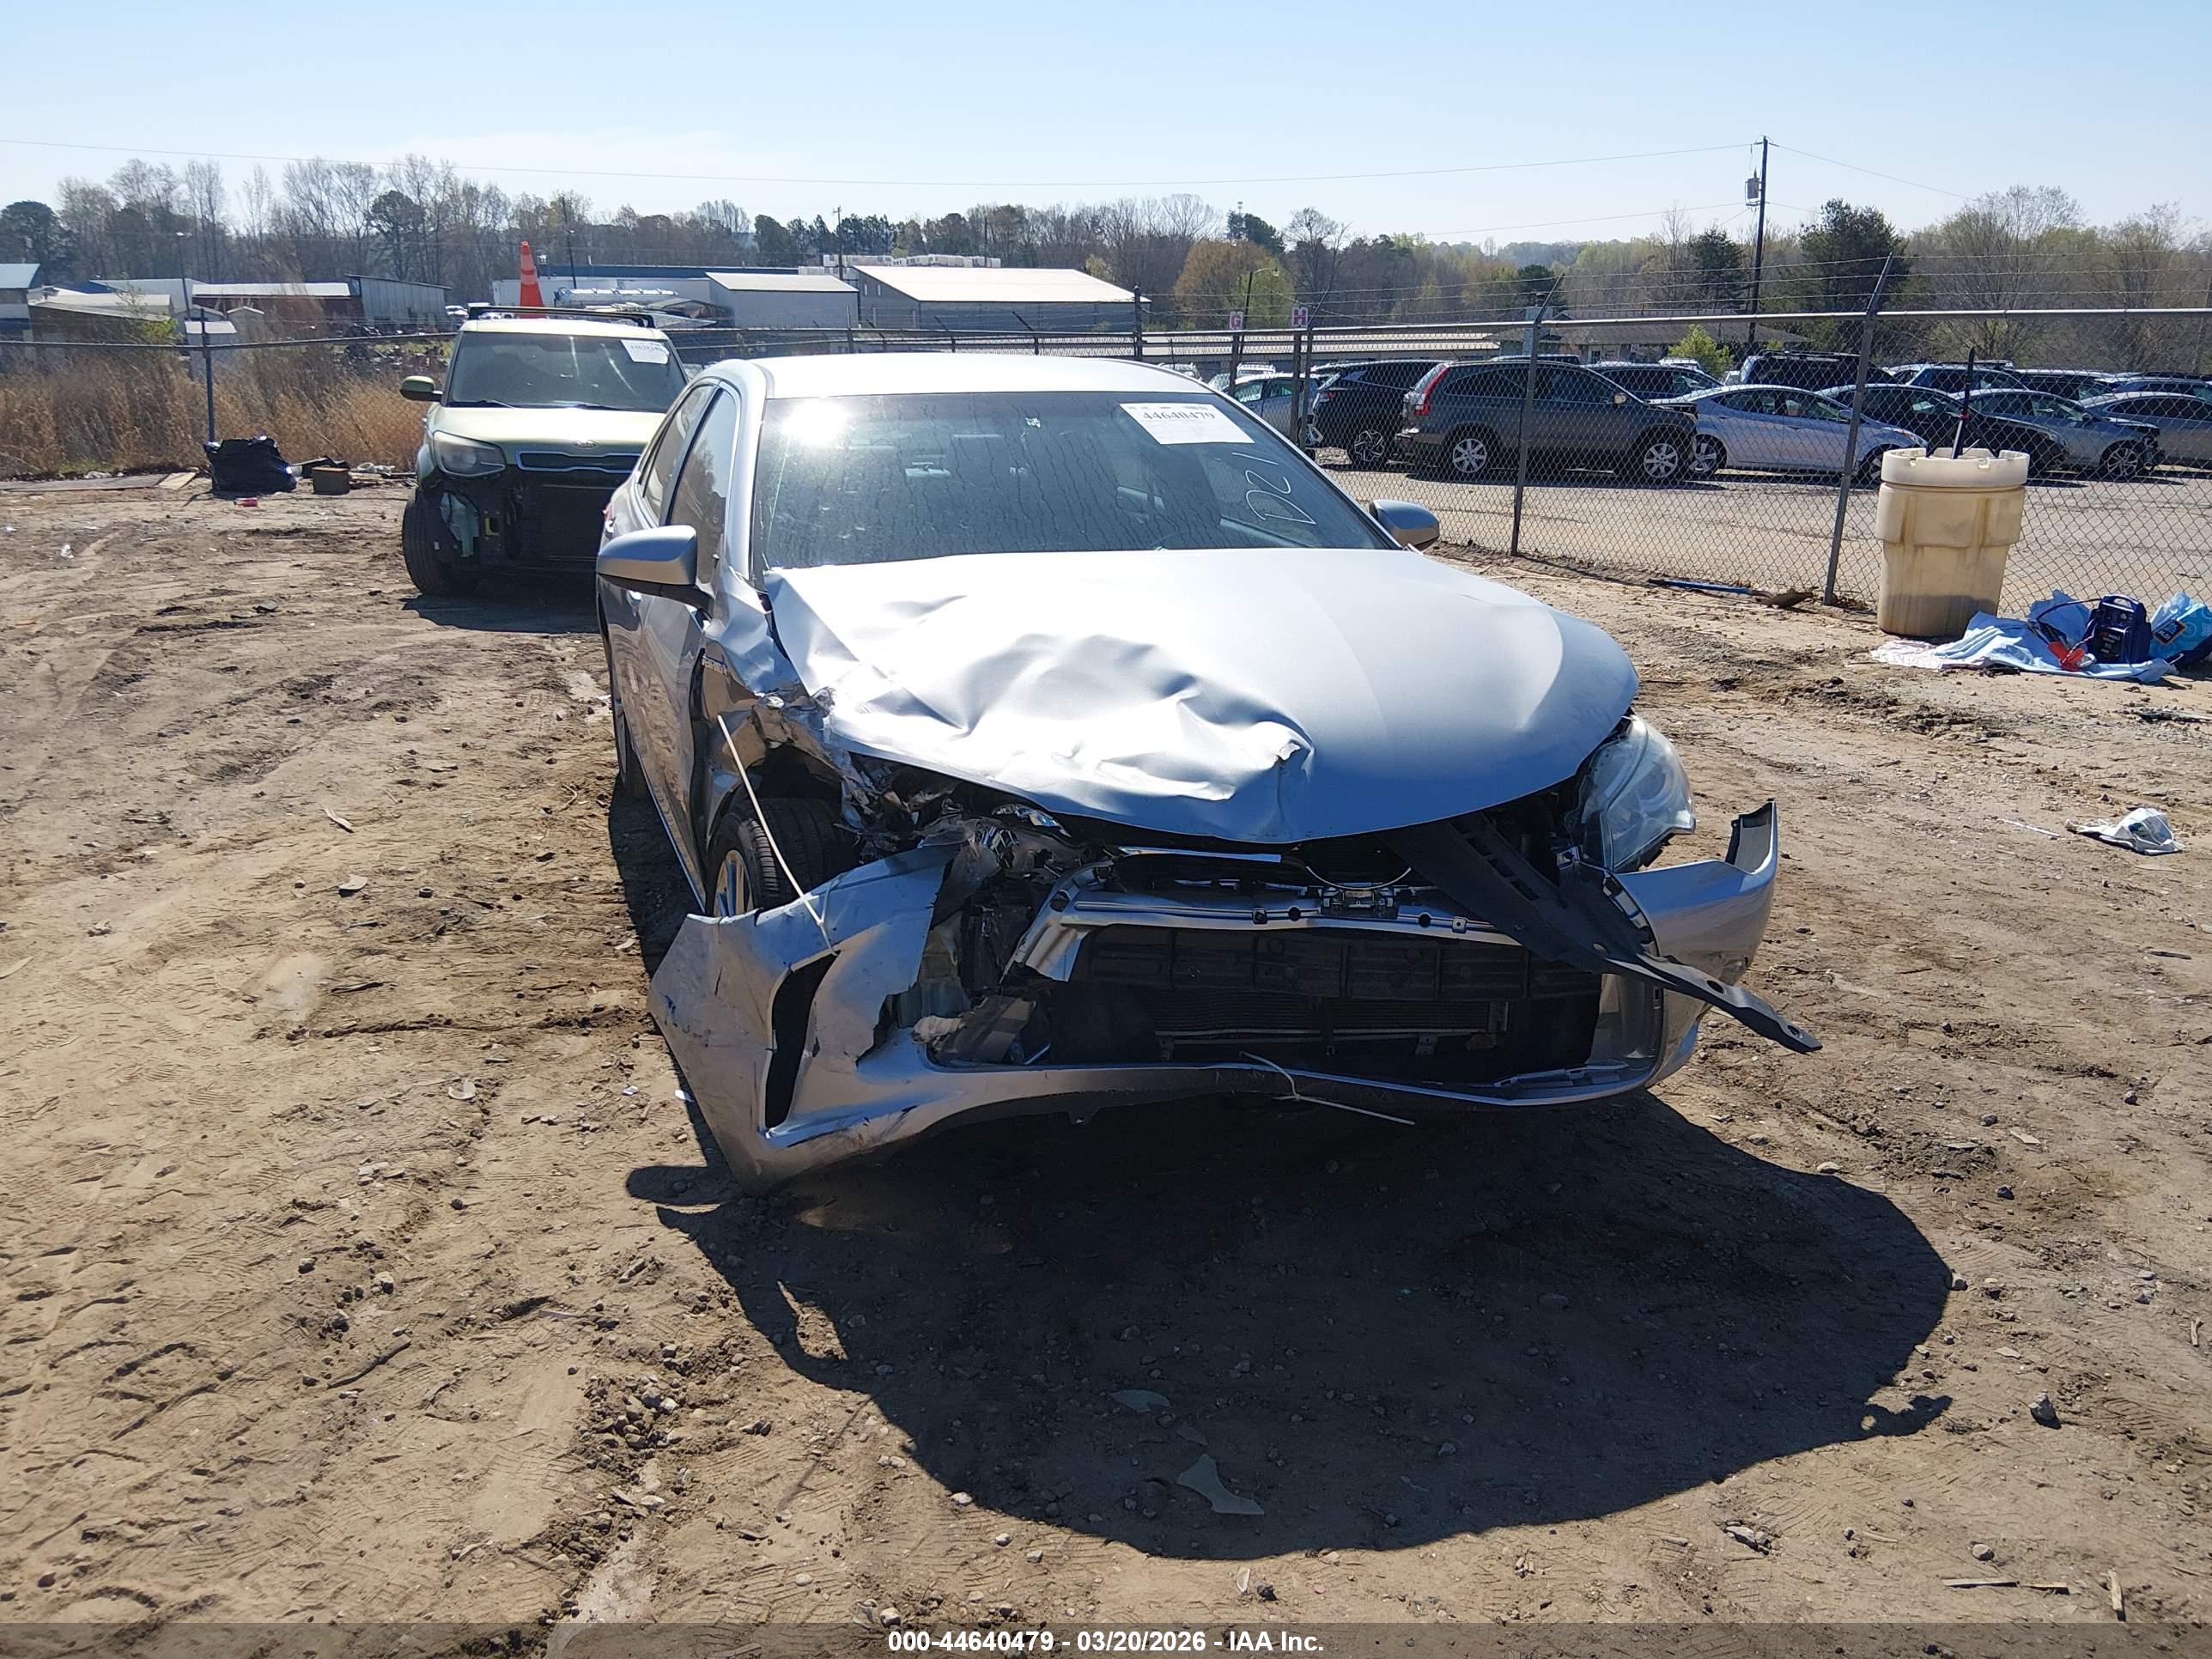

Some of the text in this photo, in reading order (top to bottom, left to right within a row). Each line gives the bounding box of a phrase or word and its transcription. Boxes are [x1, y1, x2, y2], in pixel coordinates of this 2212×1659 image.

[1231, 315, 1242, 330] G
[1293, 309, 1307, 326] H
[1143, 411, 1215, 420] 44640479
